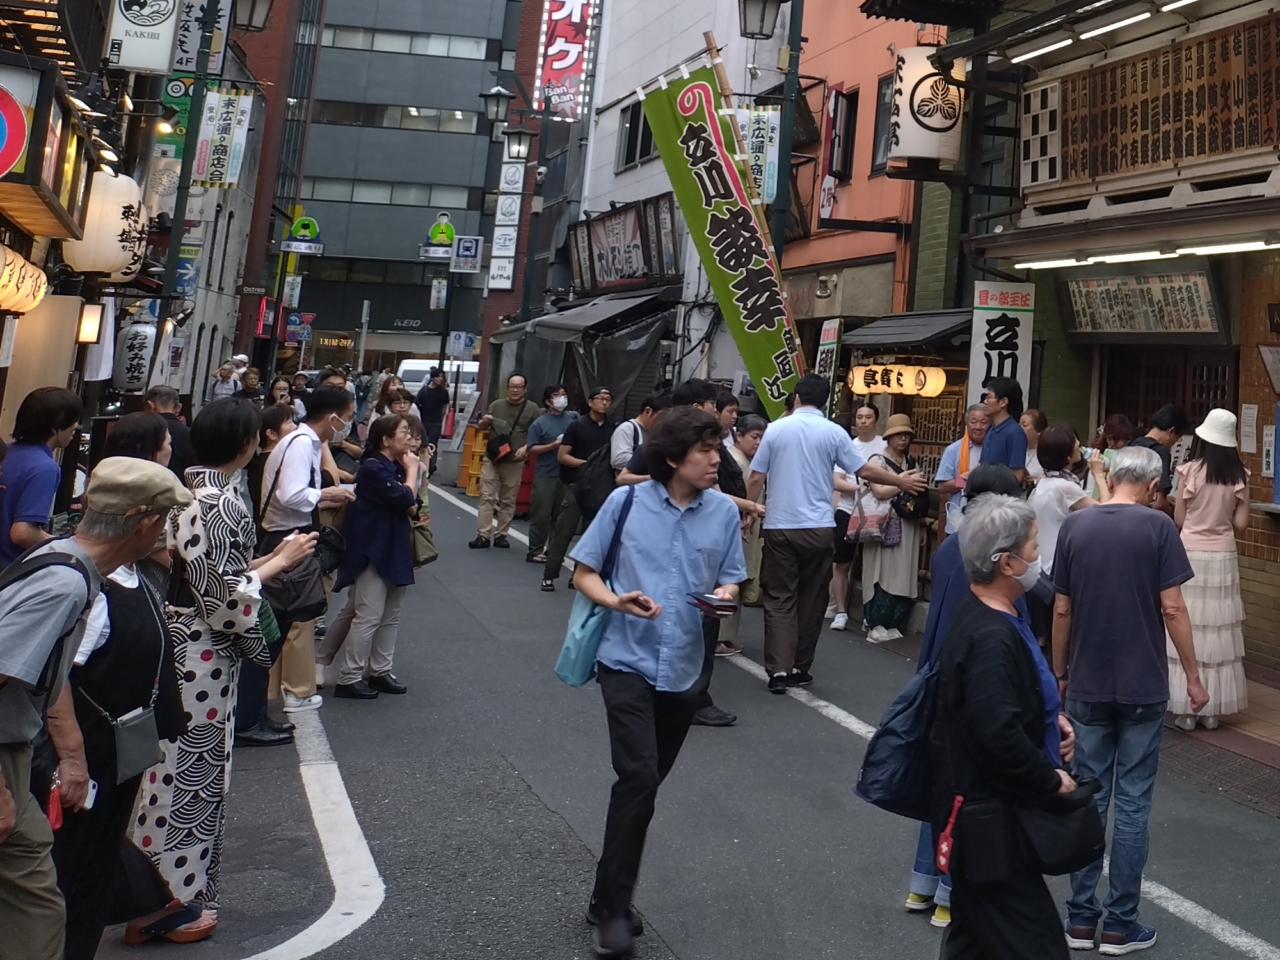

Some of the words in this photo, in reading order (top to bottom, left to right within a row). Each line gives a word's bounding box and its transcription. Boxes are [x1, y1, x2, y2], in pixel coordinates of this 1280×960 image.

[124, 29, 160, 40] KAKIBI
[176, 56, 194, 67] 4F
[749, 113, 767, 198] 末広通り商店
[126, 330, 148, 385] お好み焼き
